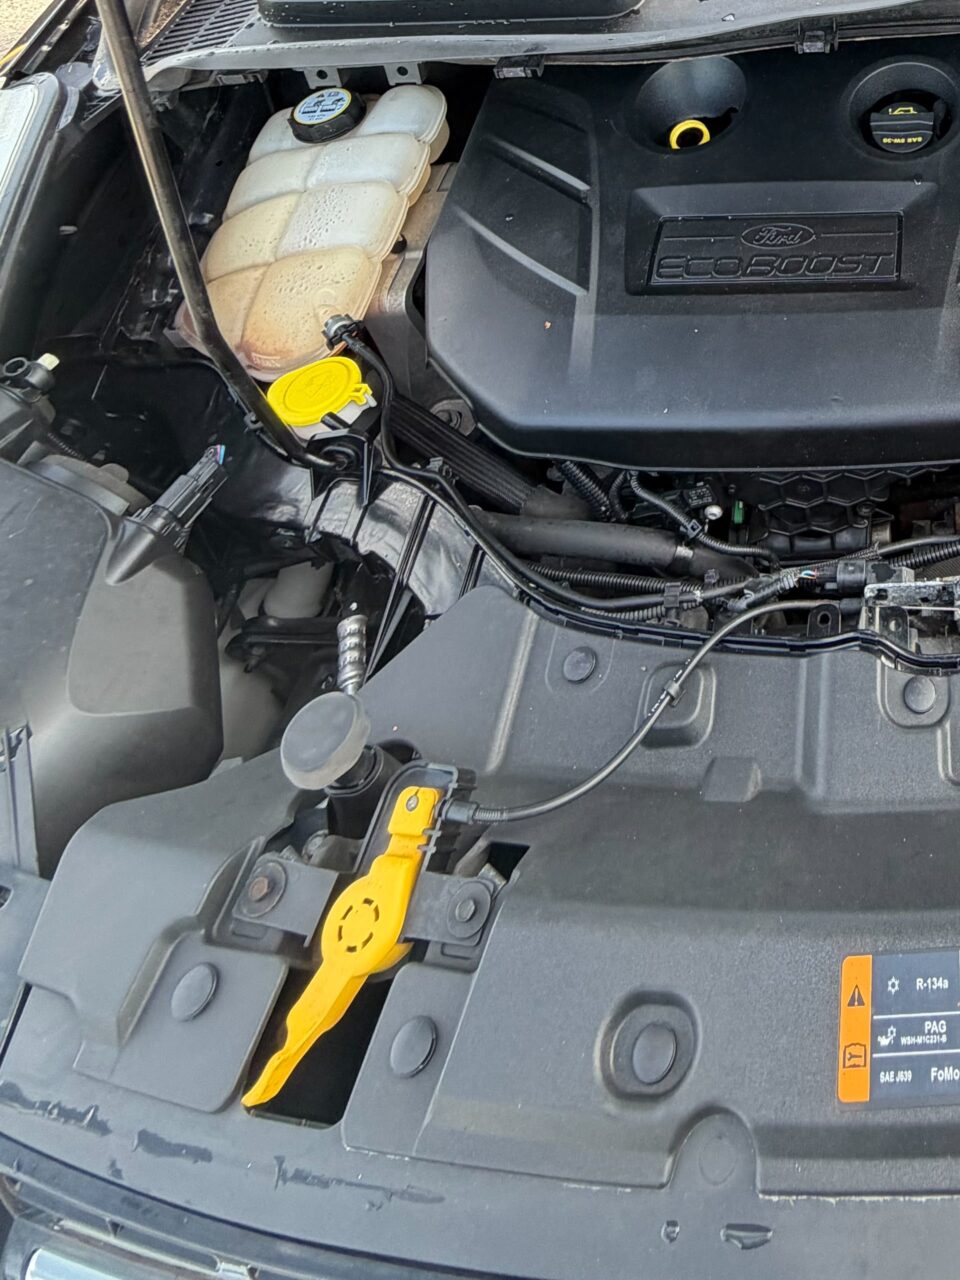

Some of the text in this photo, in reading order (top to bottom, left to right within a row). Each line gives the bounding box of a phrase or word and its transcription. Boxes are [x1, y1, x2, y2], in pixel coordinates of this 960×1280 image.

[754, 225, 802, 245] Ford
[654, 253, 895, 280] ECOBOOST
[916, 976, 949, 992] R-134a
[924, 1019, 947, 1035] PAG
[879, 1069, 912, 1083] SAE J639
